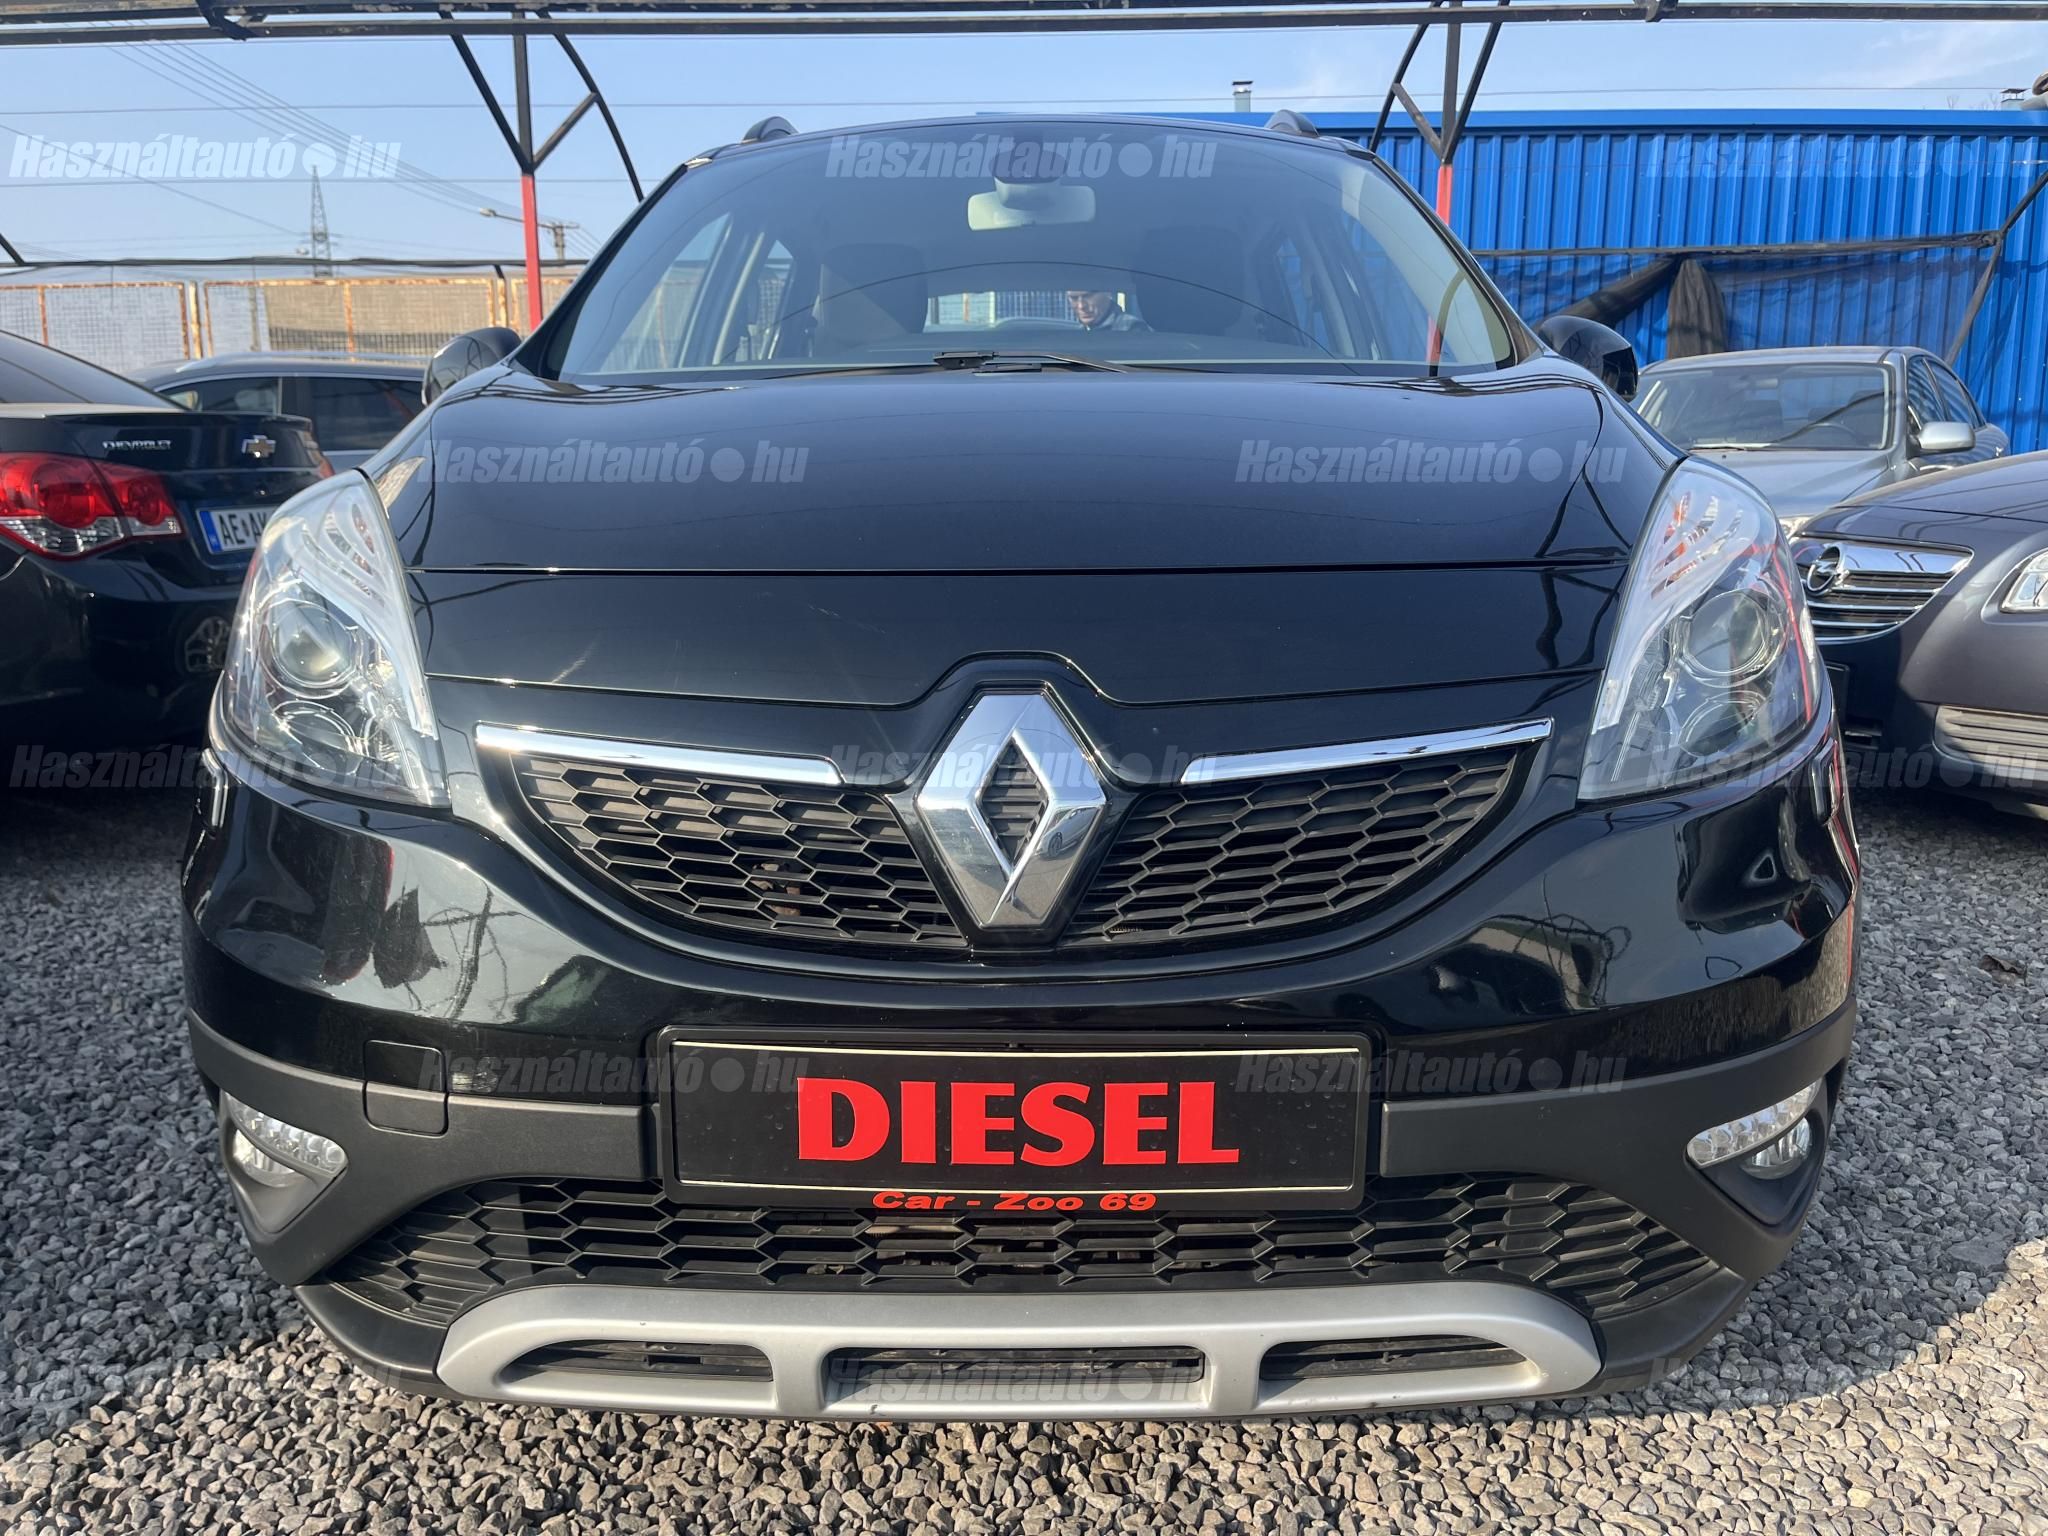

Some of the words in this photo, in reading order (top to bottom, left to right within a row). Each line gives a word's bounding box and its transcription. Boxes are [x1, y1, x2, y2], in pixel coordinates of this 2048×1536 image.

[797, 1077, 1240, 1167] DIESEL
[872, 1191, 955, 1210] Car
[994, 1192, 1084, 1211] Zoo
[1099, 1192, 1157, 1211] 69
